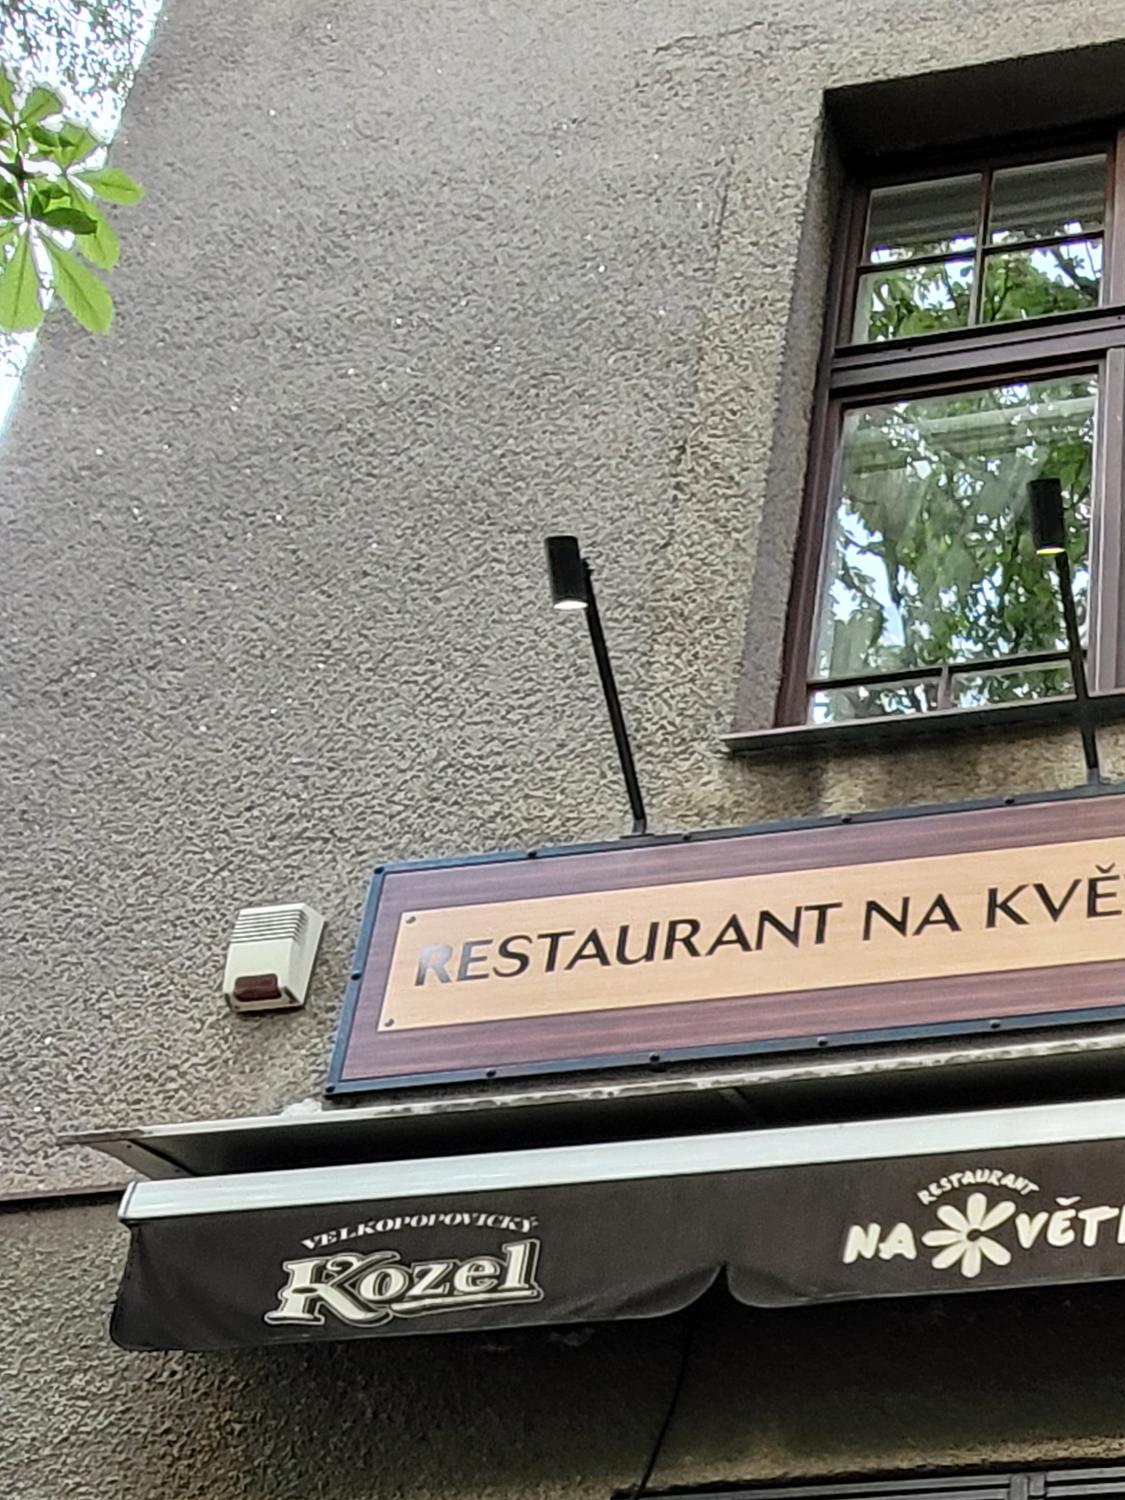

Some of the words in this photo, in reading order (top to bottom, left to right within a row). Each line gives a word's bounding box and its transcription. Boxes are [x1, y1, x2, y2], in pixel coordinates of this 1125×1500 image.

[414, 901, 844, 987] RESTAURANT
[862, 893, 962, 941] NA
[916, 1168, 1040, 1206] RESTAURANT
[300, 1212, 540, 1250] VELKOPOPOVICKÝ
[843, 1221, 918, 1264] NA
[264, 1238, 545, 1328] Kozel
